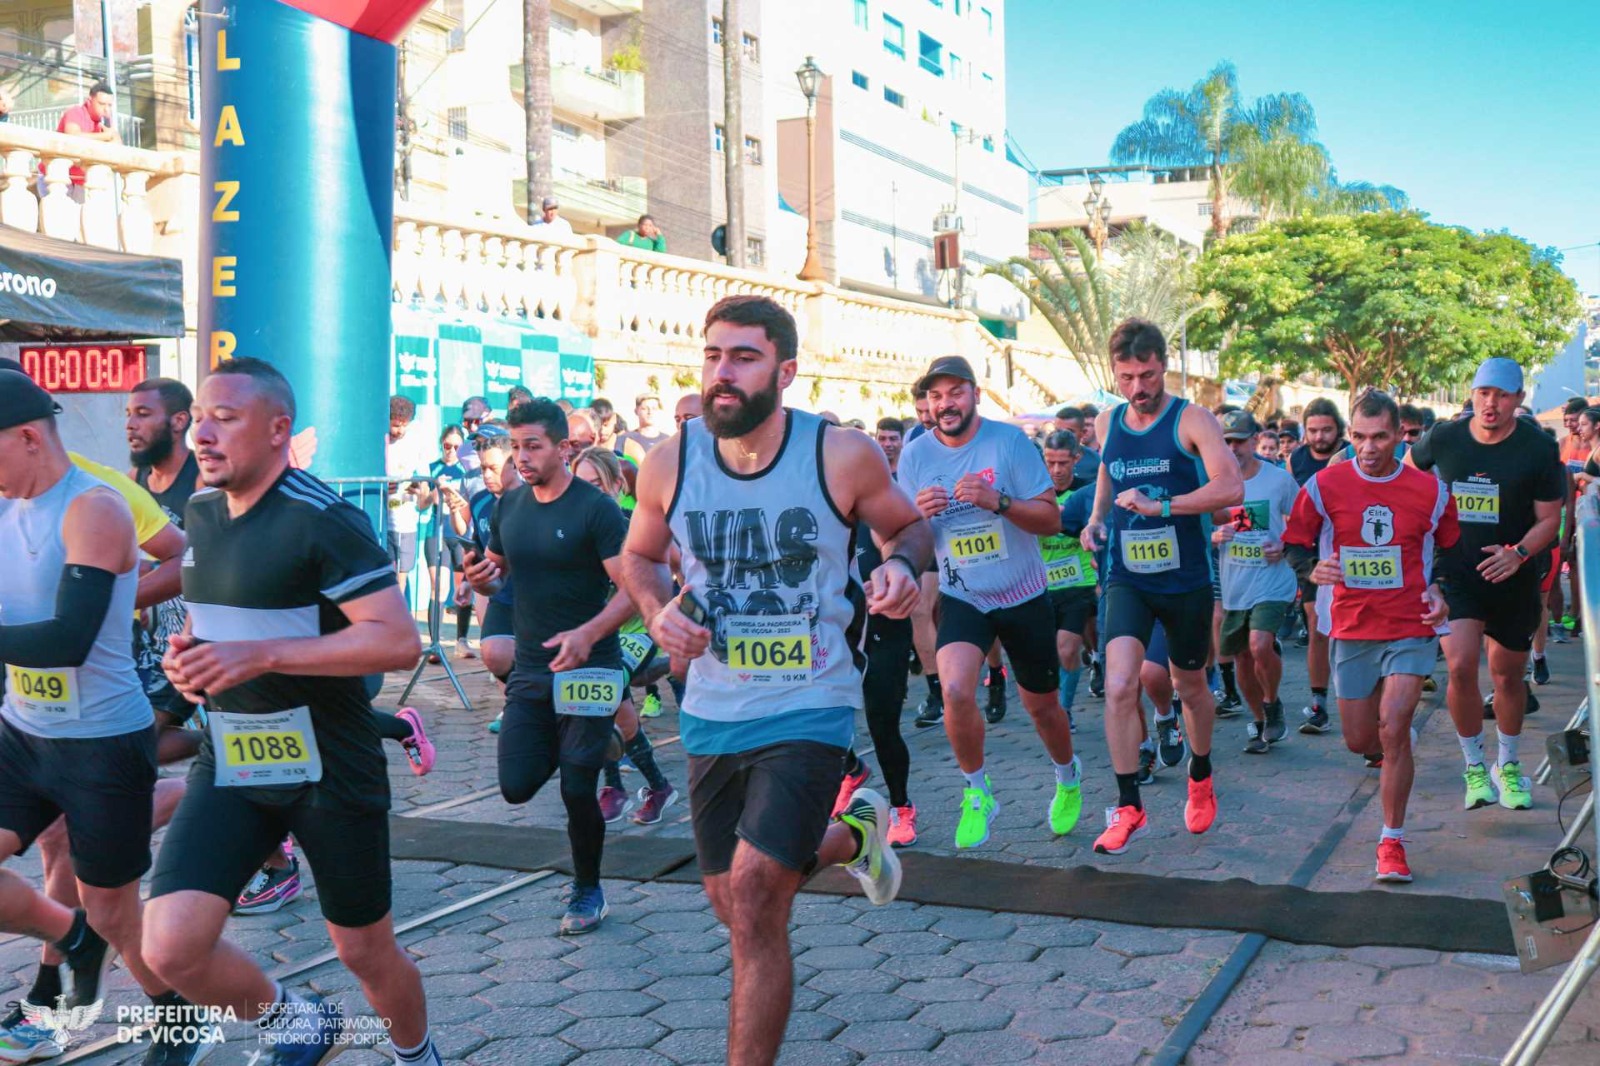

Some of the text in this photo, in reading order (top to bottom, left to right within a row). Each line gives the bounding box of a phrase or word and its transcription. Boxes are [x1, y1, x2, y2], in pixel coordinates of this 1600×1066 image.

[209, 29, 246, 372] LAZER
[1126, 458, 1160, 468] CLUBE
[1126, 464, 1170, 476] CORRIDA
[1456, 495, 1494, 511] 1071
[1368, 509, 1388, 517] Elite
[684, 507, 819, 589] VAS
[955, 535, 995, 556] 1101
[1131, 542, 1169, 560] 1116
[1231, 545, 1261, 558] 1138
[1048, 566, 1076, 581] 1130
[1349, 560, 1392, 576] 1136
[735, 640, 806, 667] 1064
[793, 673, 807, 681] KM
[566, 683, 613, 702] 1053
[232, 735, 302, 762] 1088
